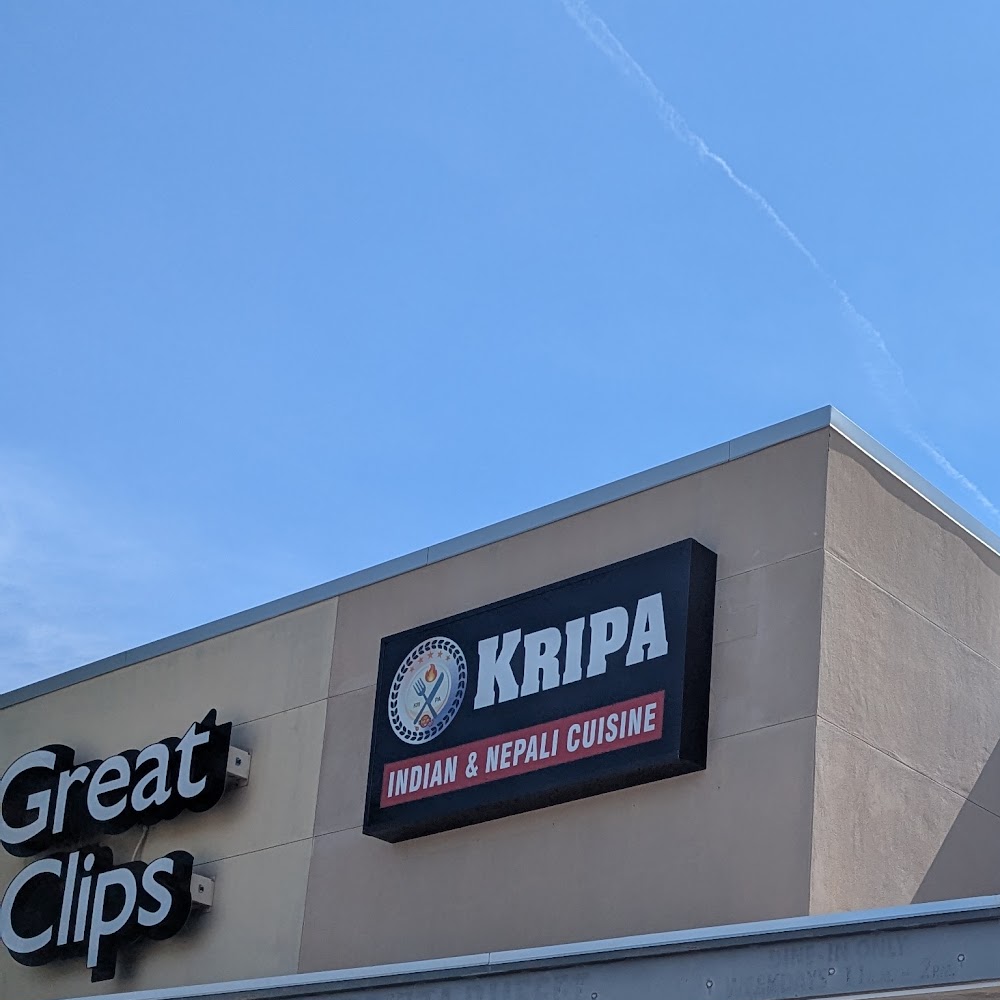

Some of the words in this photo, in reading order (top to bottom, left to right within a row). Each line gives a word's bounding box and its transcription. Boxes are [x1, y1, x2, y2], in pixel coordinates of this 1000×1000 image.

[473, 592, 669, 710] KRIPA
[0, 722, 210, 844] Great
[387, 755, 459, 798] INDIAN
[465, 751, 479, 778] &
[485, 729, 559, 773] NEPALI
[566, 702, 657, 753] CUISINE
[0, 850, 175, 968] Clips
